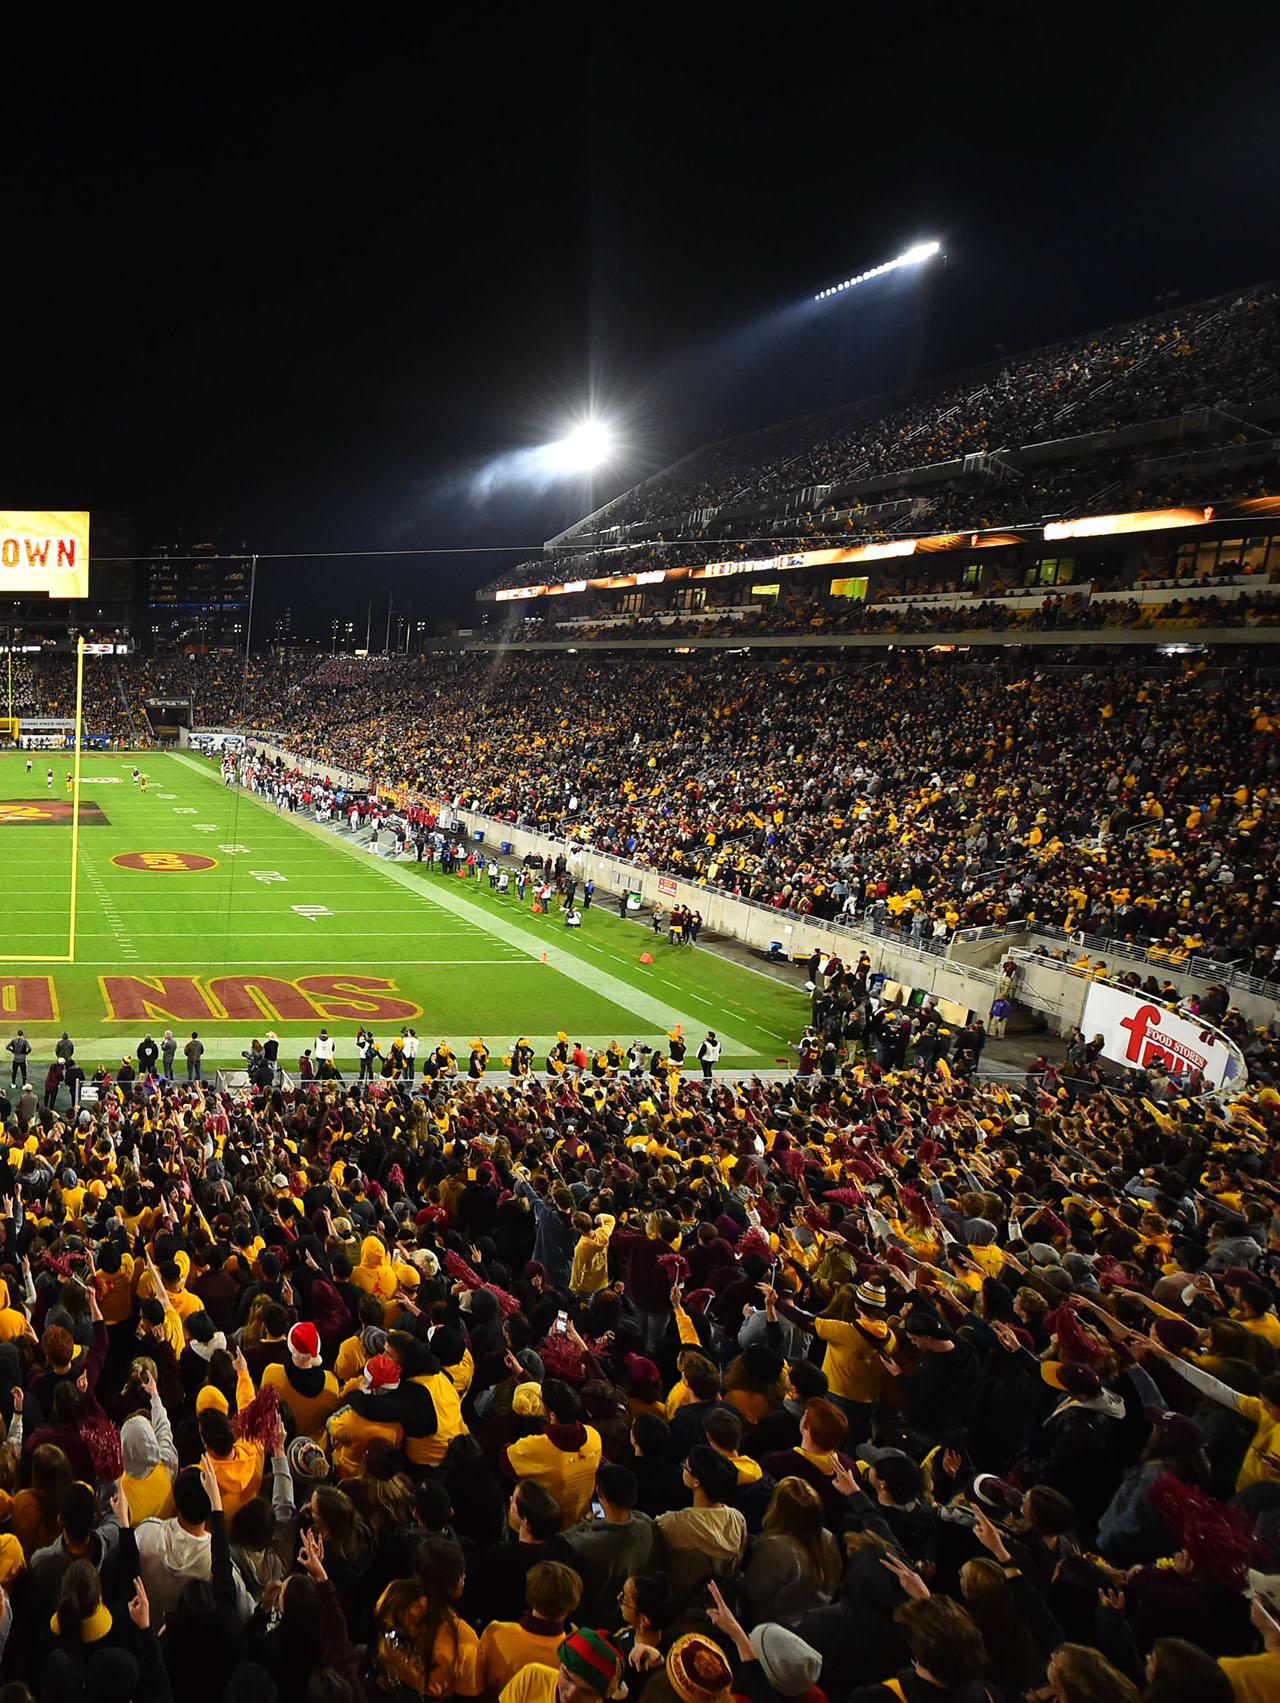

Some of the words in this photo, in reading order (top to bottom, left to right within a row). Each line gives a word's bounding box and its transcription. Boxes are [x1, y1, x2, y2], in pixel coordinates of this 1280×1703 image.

[97, 974, 424, 1022] SUN
[1146, 1027, 1173, 1048] FOOD
[1173, 1042, 1205, 1068] STORES
